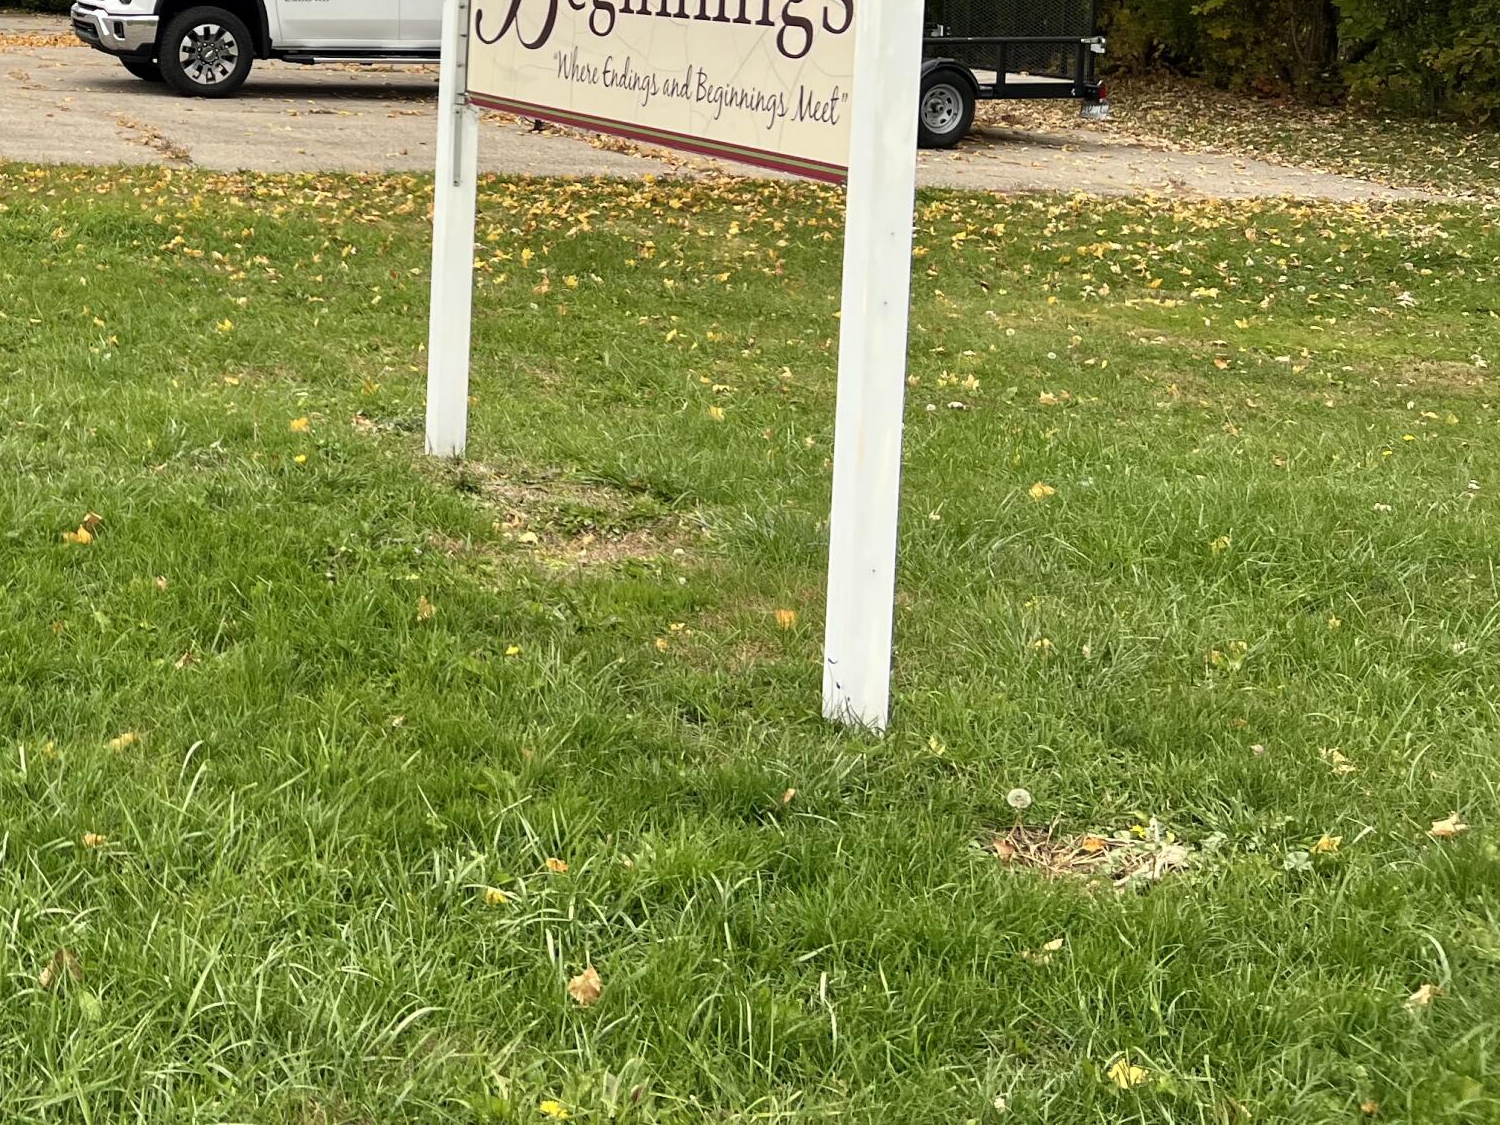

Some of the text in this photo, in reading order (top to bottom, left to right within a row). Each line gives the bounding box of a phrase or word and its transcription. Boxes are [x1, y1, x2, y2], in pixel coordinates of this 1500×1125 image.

[602, 55, 660, 107] Endings
[662, 64, 693, 101] and
[695, 66, 789, 130] Beginnings
